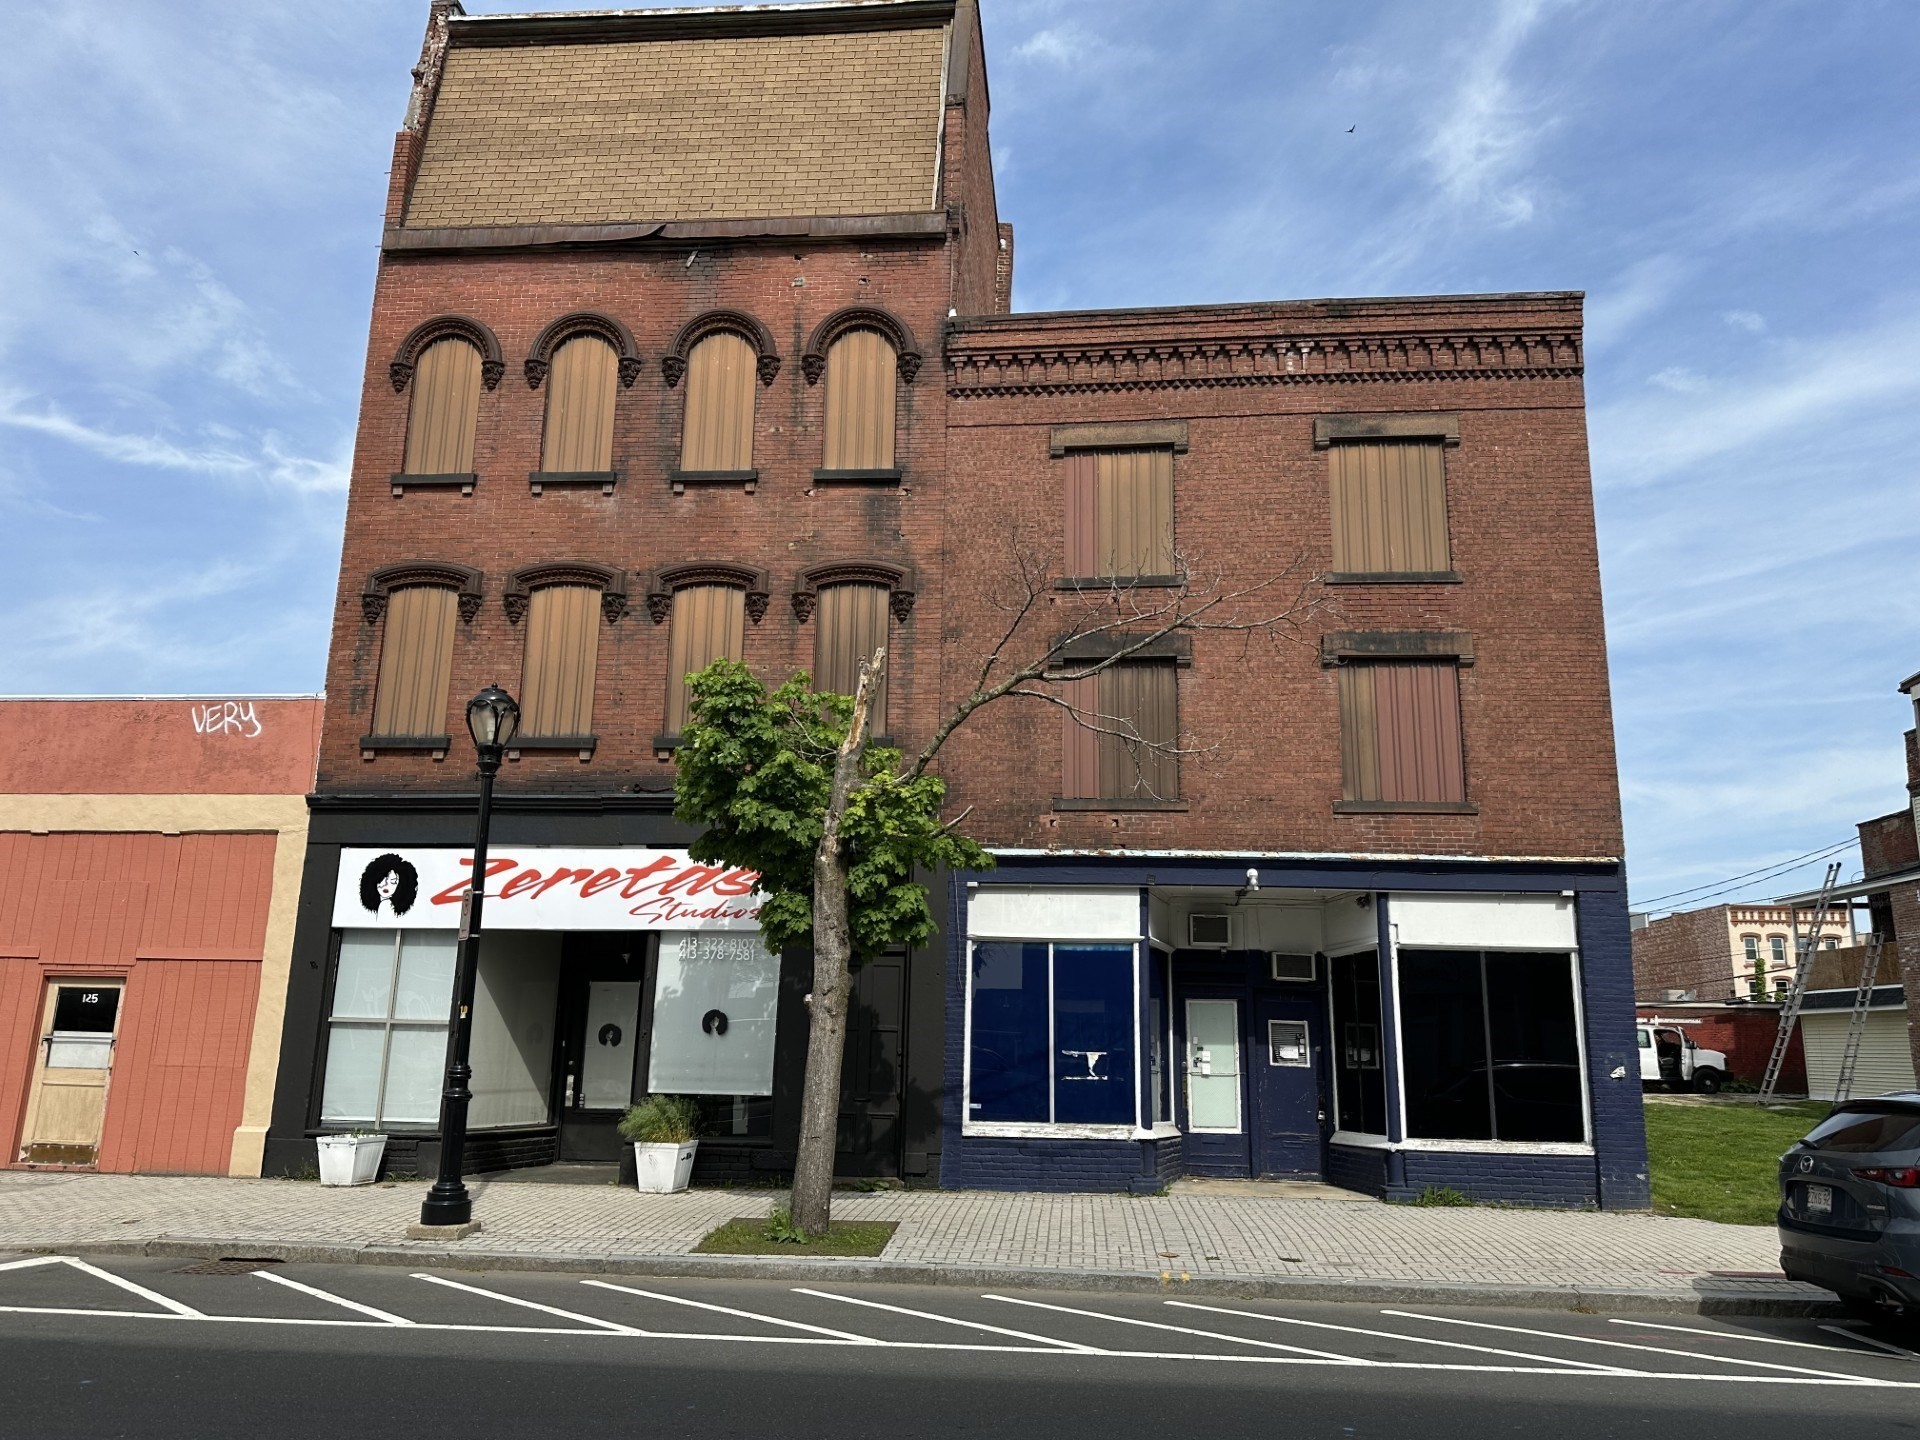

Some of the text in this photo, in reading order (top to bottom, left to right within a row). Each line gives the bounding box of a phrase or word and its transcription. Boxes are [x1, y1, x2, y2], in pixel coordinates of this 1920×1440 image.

[430, 855, 762, 905] Zeretas
[629, 896, 761, 924] Studios
[679, 937, 755, 949] 413-322-8107
[678, 948, 754, 960] 413-378-7581
[82, 993, 99, 1004] 125
